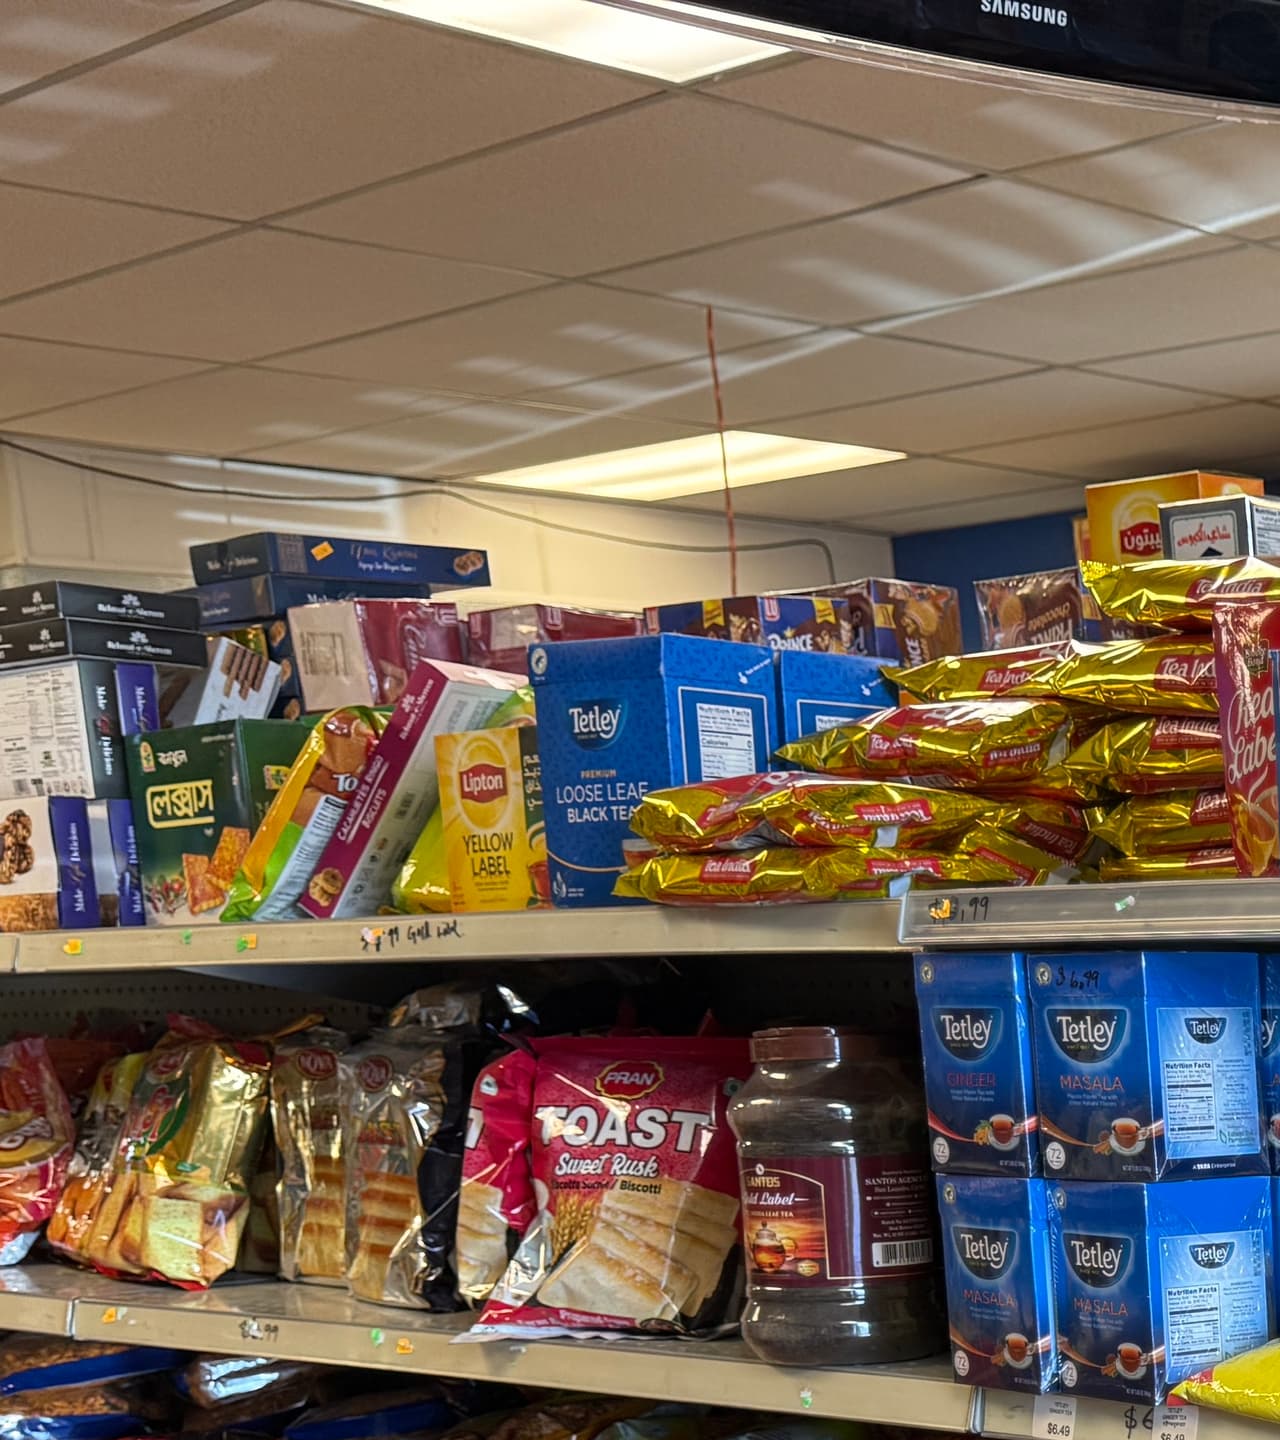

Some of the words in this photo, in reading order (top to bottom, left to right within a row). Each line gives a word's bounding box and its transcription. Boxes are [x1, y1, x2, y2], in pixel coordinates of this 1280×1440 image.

[981, 0, 1068, 28] SAMSUNG
[568, 704, 623, 740] Tetley
[461, 771, 504, 795] Lipton
[580, 768, 617, 779] PREMIUM
[556, 783, 603, 805] LOOSE
[607, 781, 649, 801] LEAF
[567, 805, 608, 824] BLACK
[609, 803, 638, 822] TEA
[462, 832, 514, 857] YELLOW
[470, 855, 511, 877] LABEL
[941, 1014, 994, 1050] Tetley
[1056, 1014, 1118, 1051] Tetley
[1190, 1019, 1222, 1038] Tetley
[603, 1070, 656, 1087] PRAN
[946, 1072, 996, 1088] GINGER
[1059, 1074, 1125, 1092] MASALA
[533, 1105, 713, 1154] TOAST
[1049, 1147, 1062, 1161] 72
[554, 1152, 605, 1177] Sweet
[609, 1152, 660, 1178] Rusk
[619, 1179, 662, 1195] Biscotti
[746, 1175, 781, 1188] SANTOS
[960, 1233, 1009, 1269] Tetley
[1071, 1239, 1124, 1277] Tetley
[1193, 1244, 1230, 1263] Tetley
[962, 1288, 1017, 1308] MASALA
[1073, 1298, 1129, 1317] MASALA
[1047, 1422, 1071, 1438] $6.49
